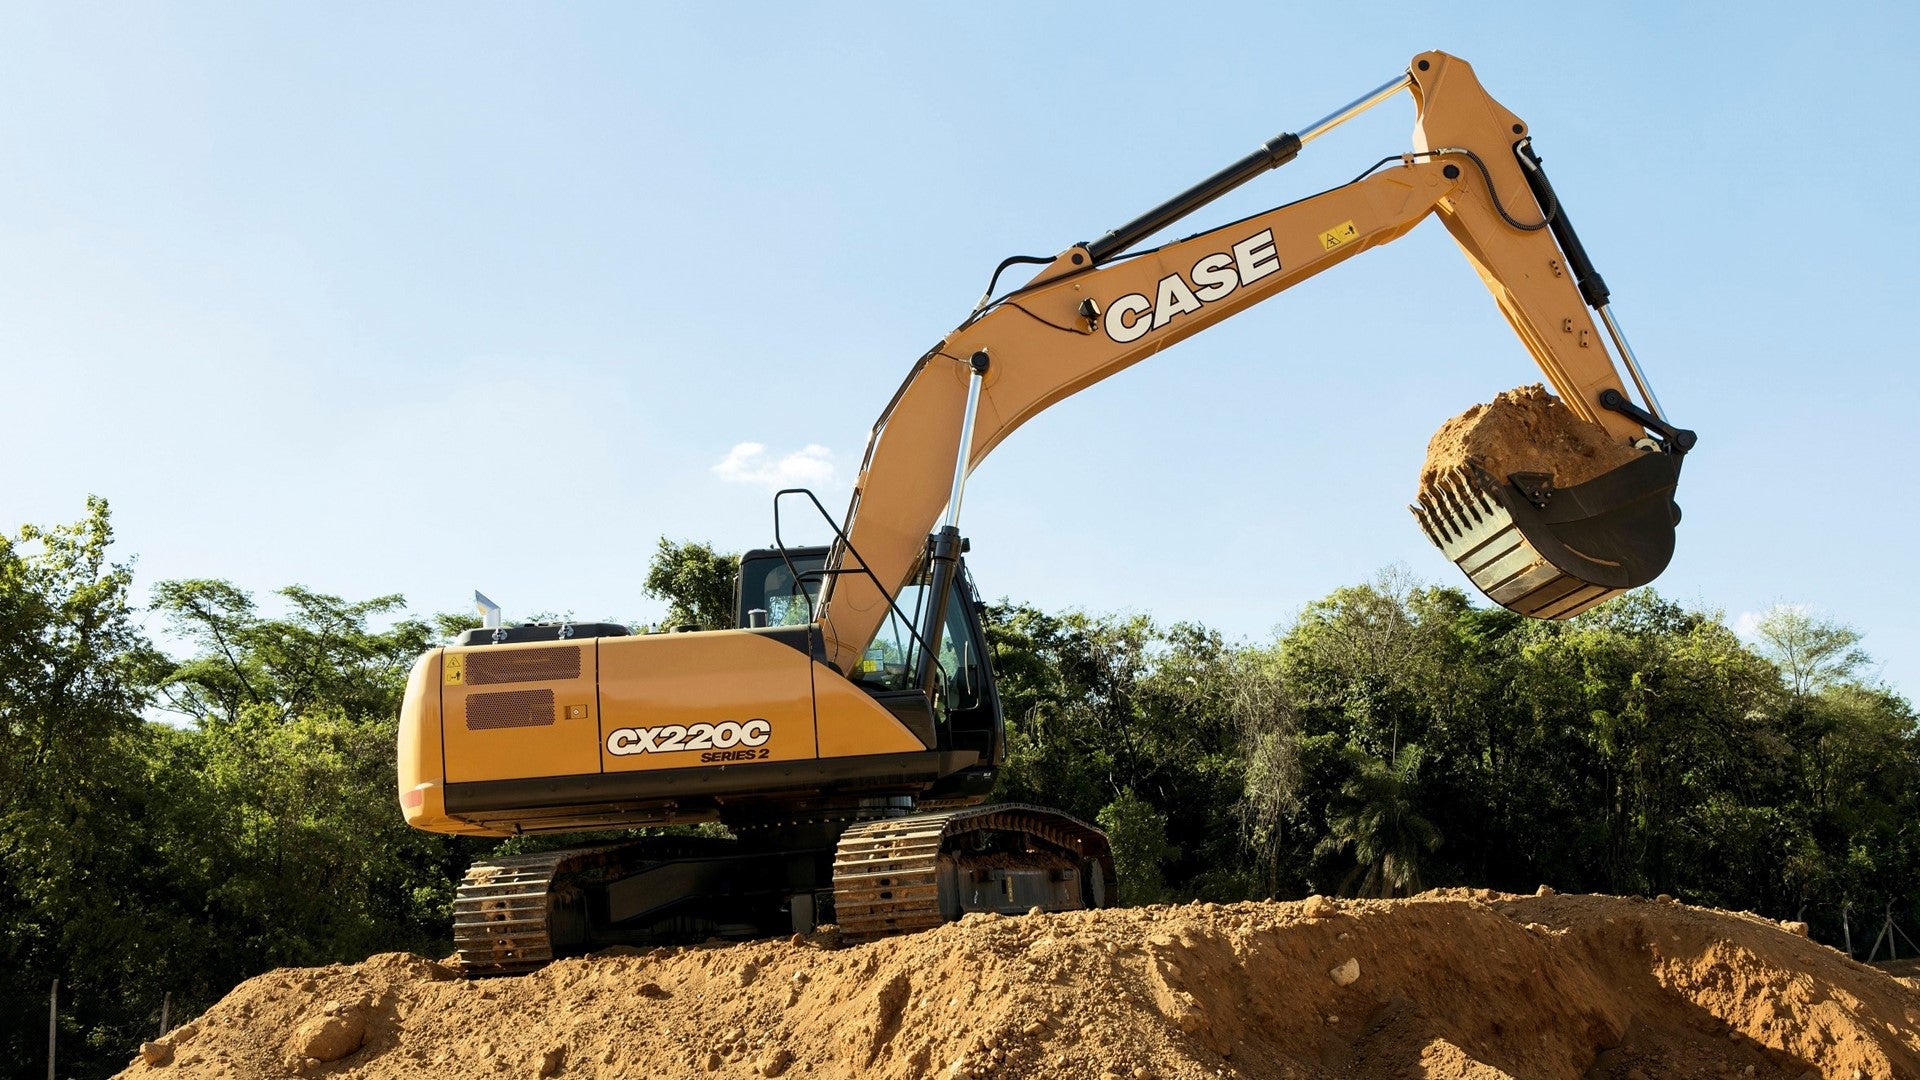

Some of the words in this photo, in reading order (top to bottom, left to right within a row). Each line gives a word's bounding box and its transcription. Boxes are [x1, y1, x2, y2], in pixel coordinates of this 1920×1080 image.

[1104, 227, 1281, 343] CASE
[606, 719, 771, 756] CX220C
[701, 749, 756, 763] SERIES
[758, 748, 770, 759] 2
